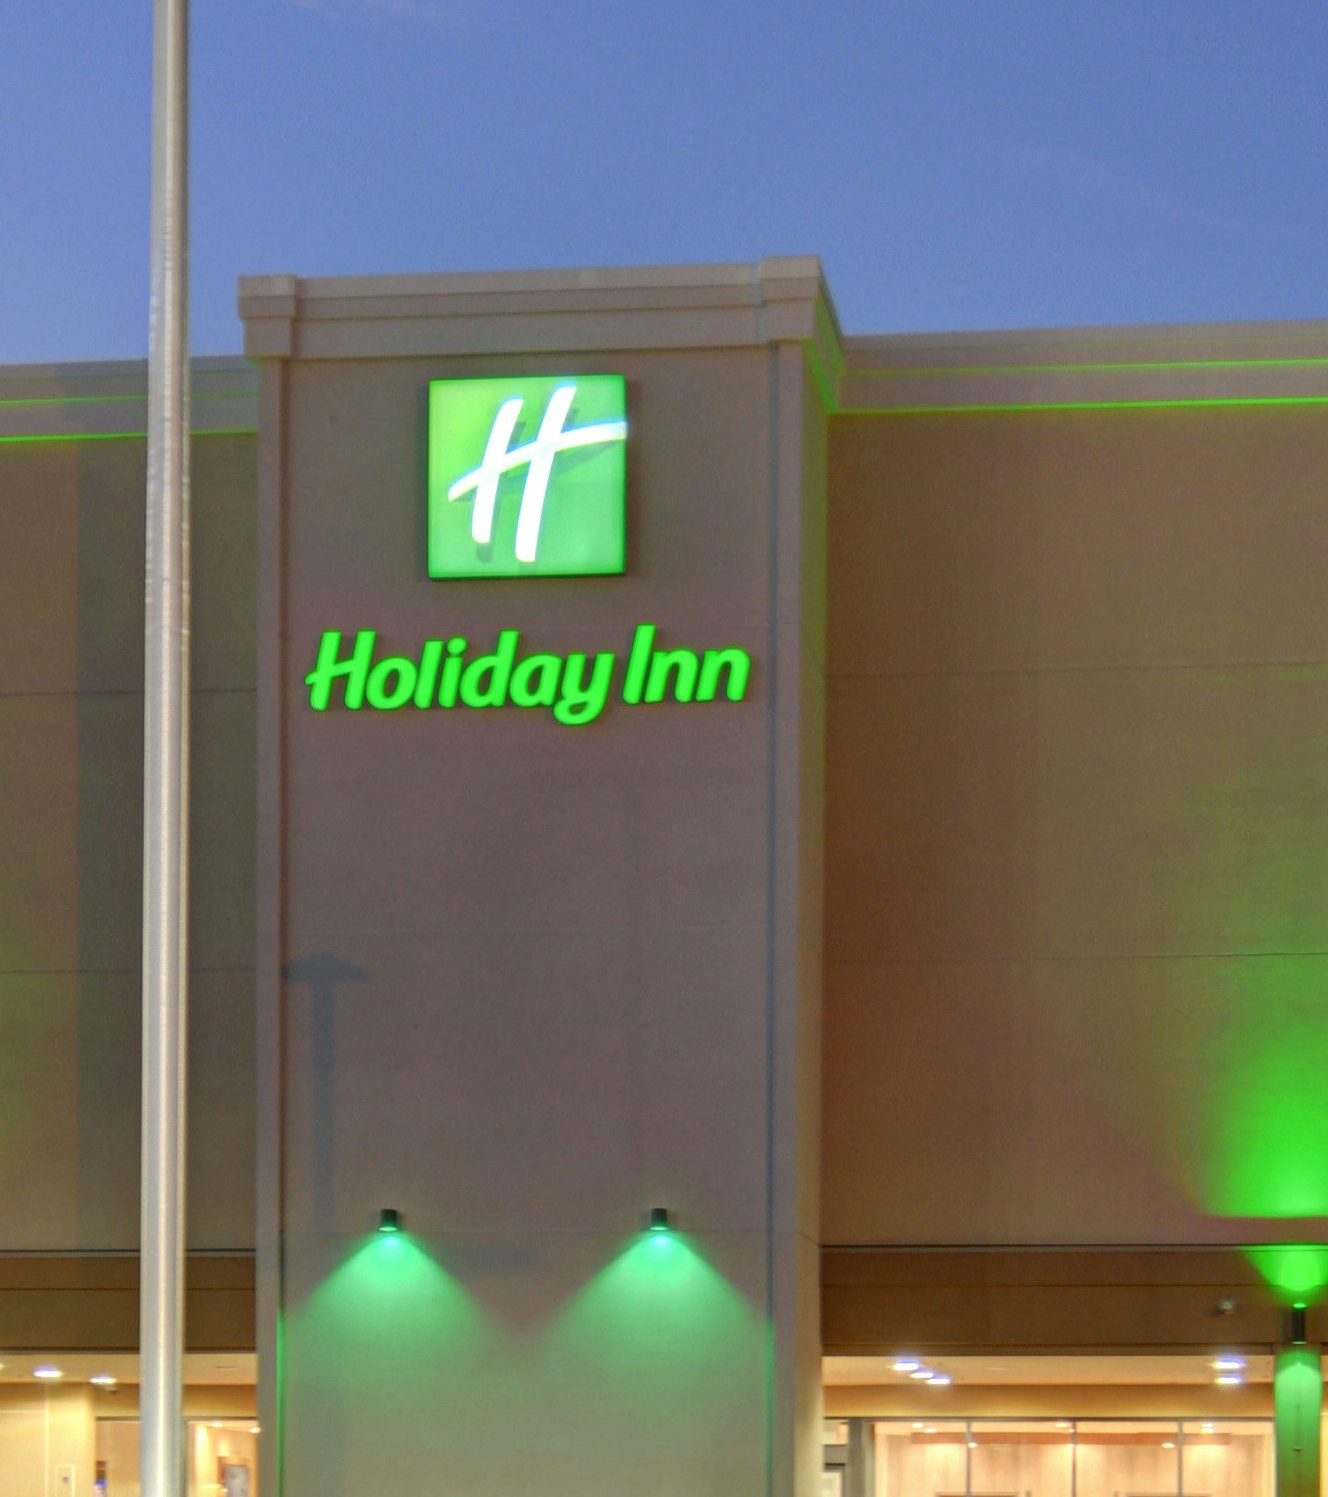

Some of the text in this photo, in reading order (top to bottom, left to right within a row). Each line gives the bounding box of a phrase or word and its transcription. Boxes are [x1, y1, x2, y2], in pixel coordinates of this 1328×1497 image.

[449, 387, 628, 562] H
[306, 624, 750, 725] Holiday Inn
